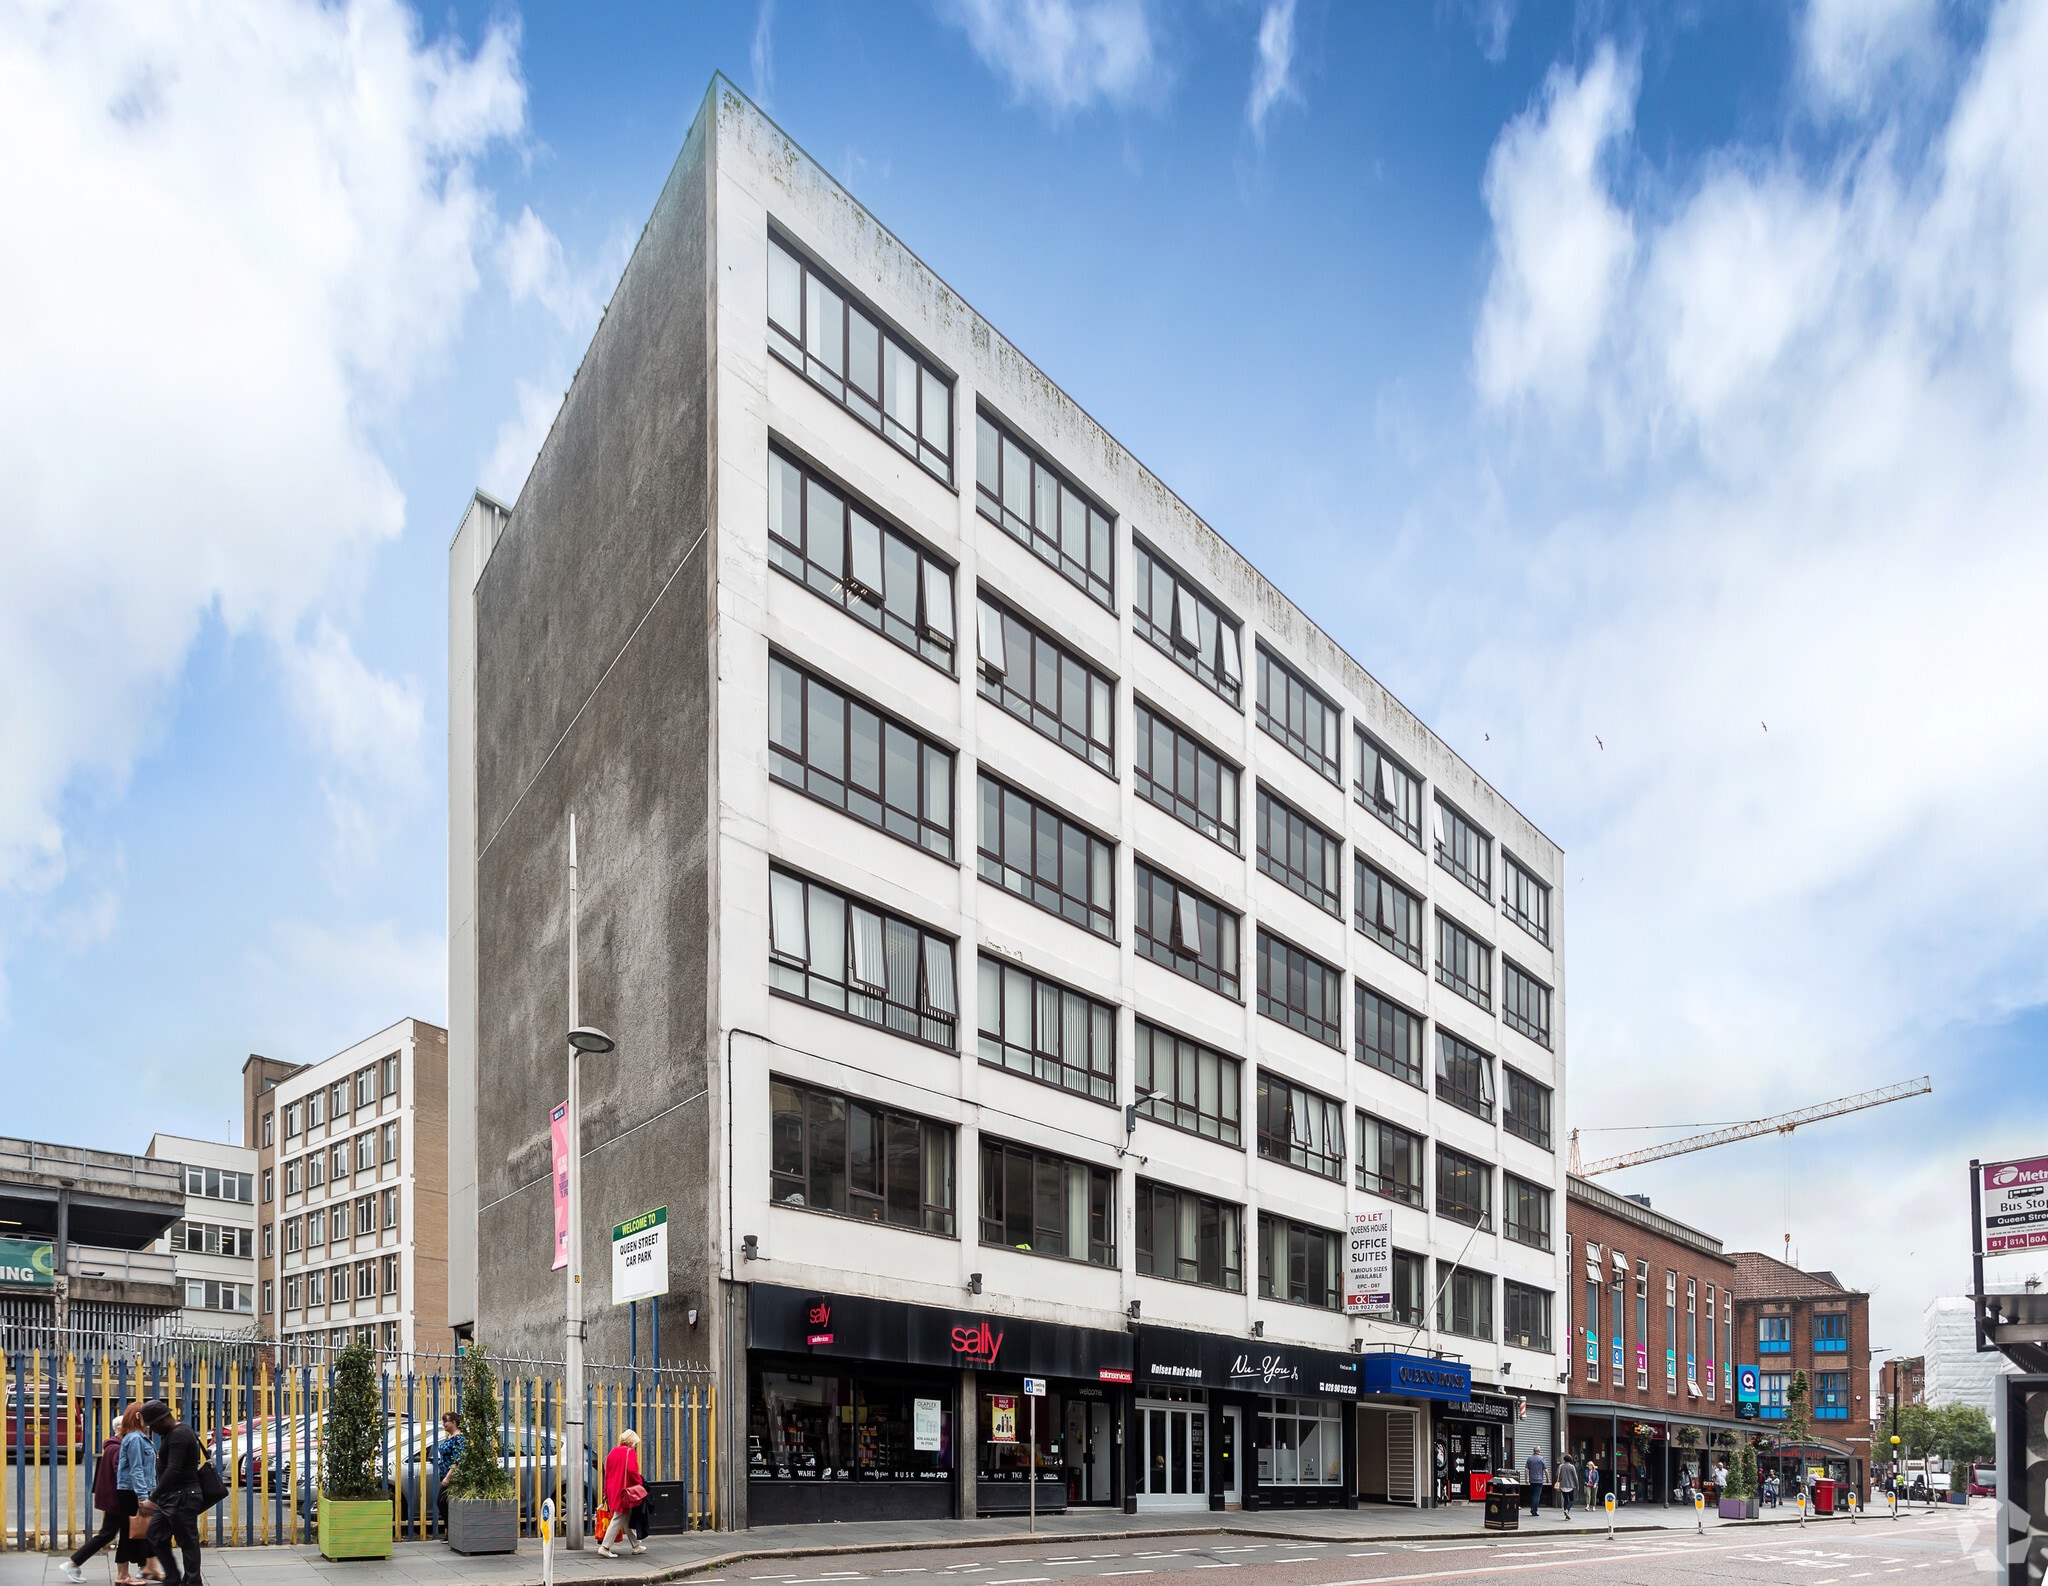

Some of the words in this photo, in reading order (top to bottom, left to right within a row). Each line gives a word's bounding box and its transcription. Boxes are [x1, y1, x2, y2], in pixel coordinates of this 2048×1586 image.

[2000, 1202, 2022, 1212] Bus
[2026, 1199, 2048, 1209] Sto
[1355, 1215, 1366, 1223] TO
[1368, 1212, 1383, 1221] LET
[1997, 1215, 2025, 1224] Queen
[2028, 1213, 2048, 1221] Stre
[622, 1216, 648, 1235] WELCOME
[648, 1213, 656, 1225] TO
[1350, 1225, 1369, 1235] QUEENS
[1370, 1223, 1387, 1232] HOUSE
[620, 1240, 637, 1255] QUEEN
[638, 1232, 658, 1249] STREET
[1351, 1238, 1387, 1250] OFFICE
[2009, 1238, 2025, 1246] 81A
[2030, 1235, 2047, 1243] 80A
[626, 1255, 636, 1267] CAR
[637, 1249, 652, 1264] PARK
[1351, 1251, 1387, 1262] SUITES
[951, 1322, 1003, 1364] sally
[1151, 1363, 1172, 1375] Unisex
[1172, 1365, 1185, 1376] Hair
[1185, 1367, 1202, 1378] Salon
[1399, 1366, 1435, 1385] QUEENS
[1437, 1371, 1466, 1389] HOUSE
[1079, 1388, 1102, 1397] welcome
[1461, 1401, 1485, 1413] KURDISH
[1485, 1404, 1508, 1417] BARBERS
